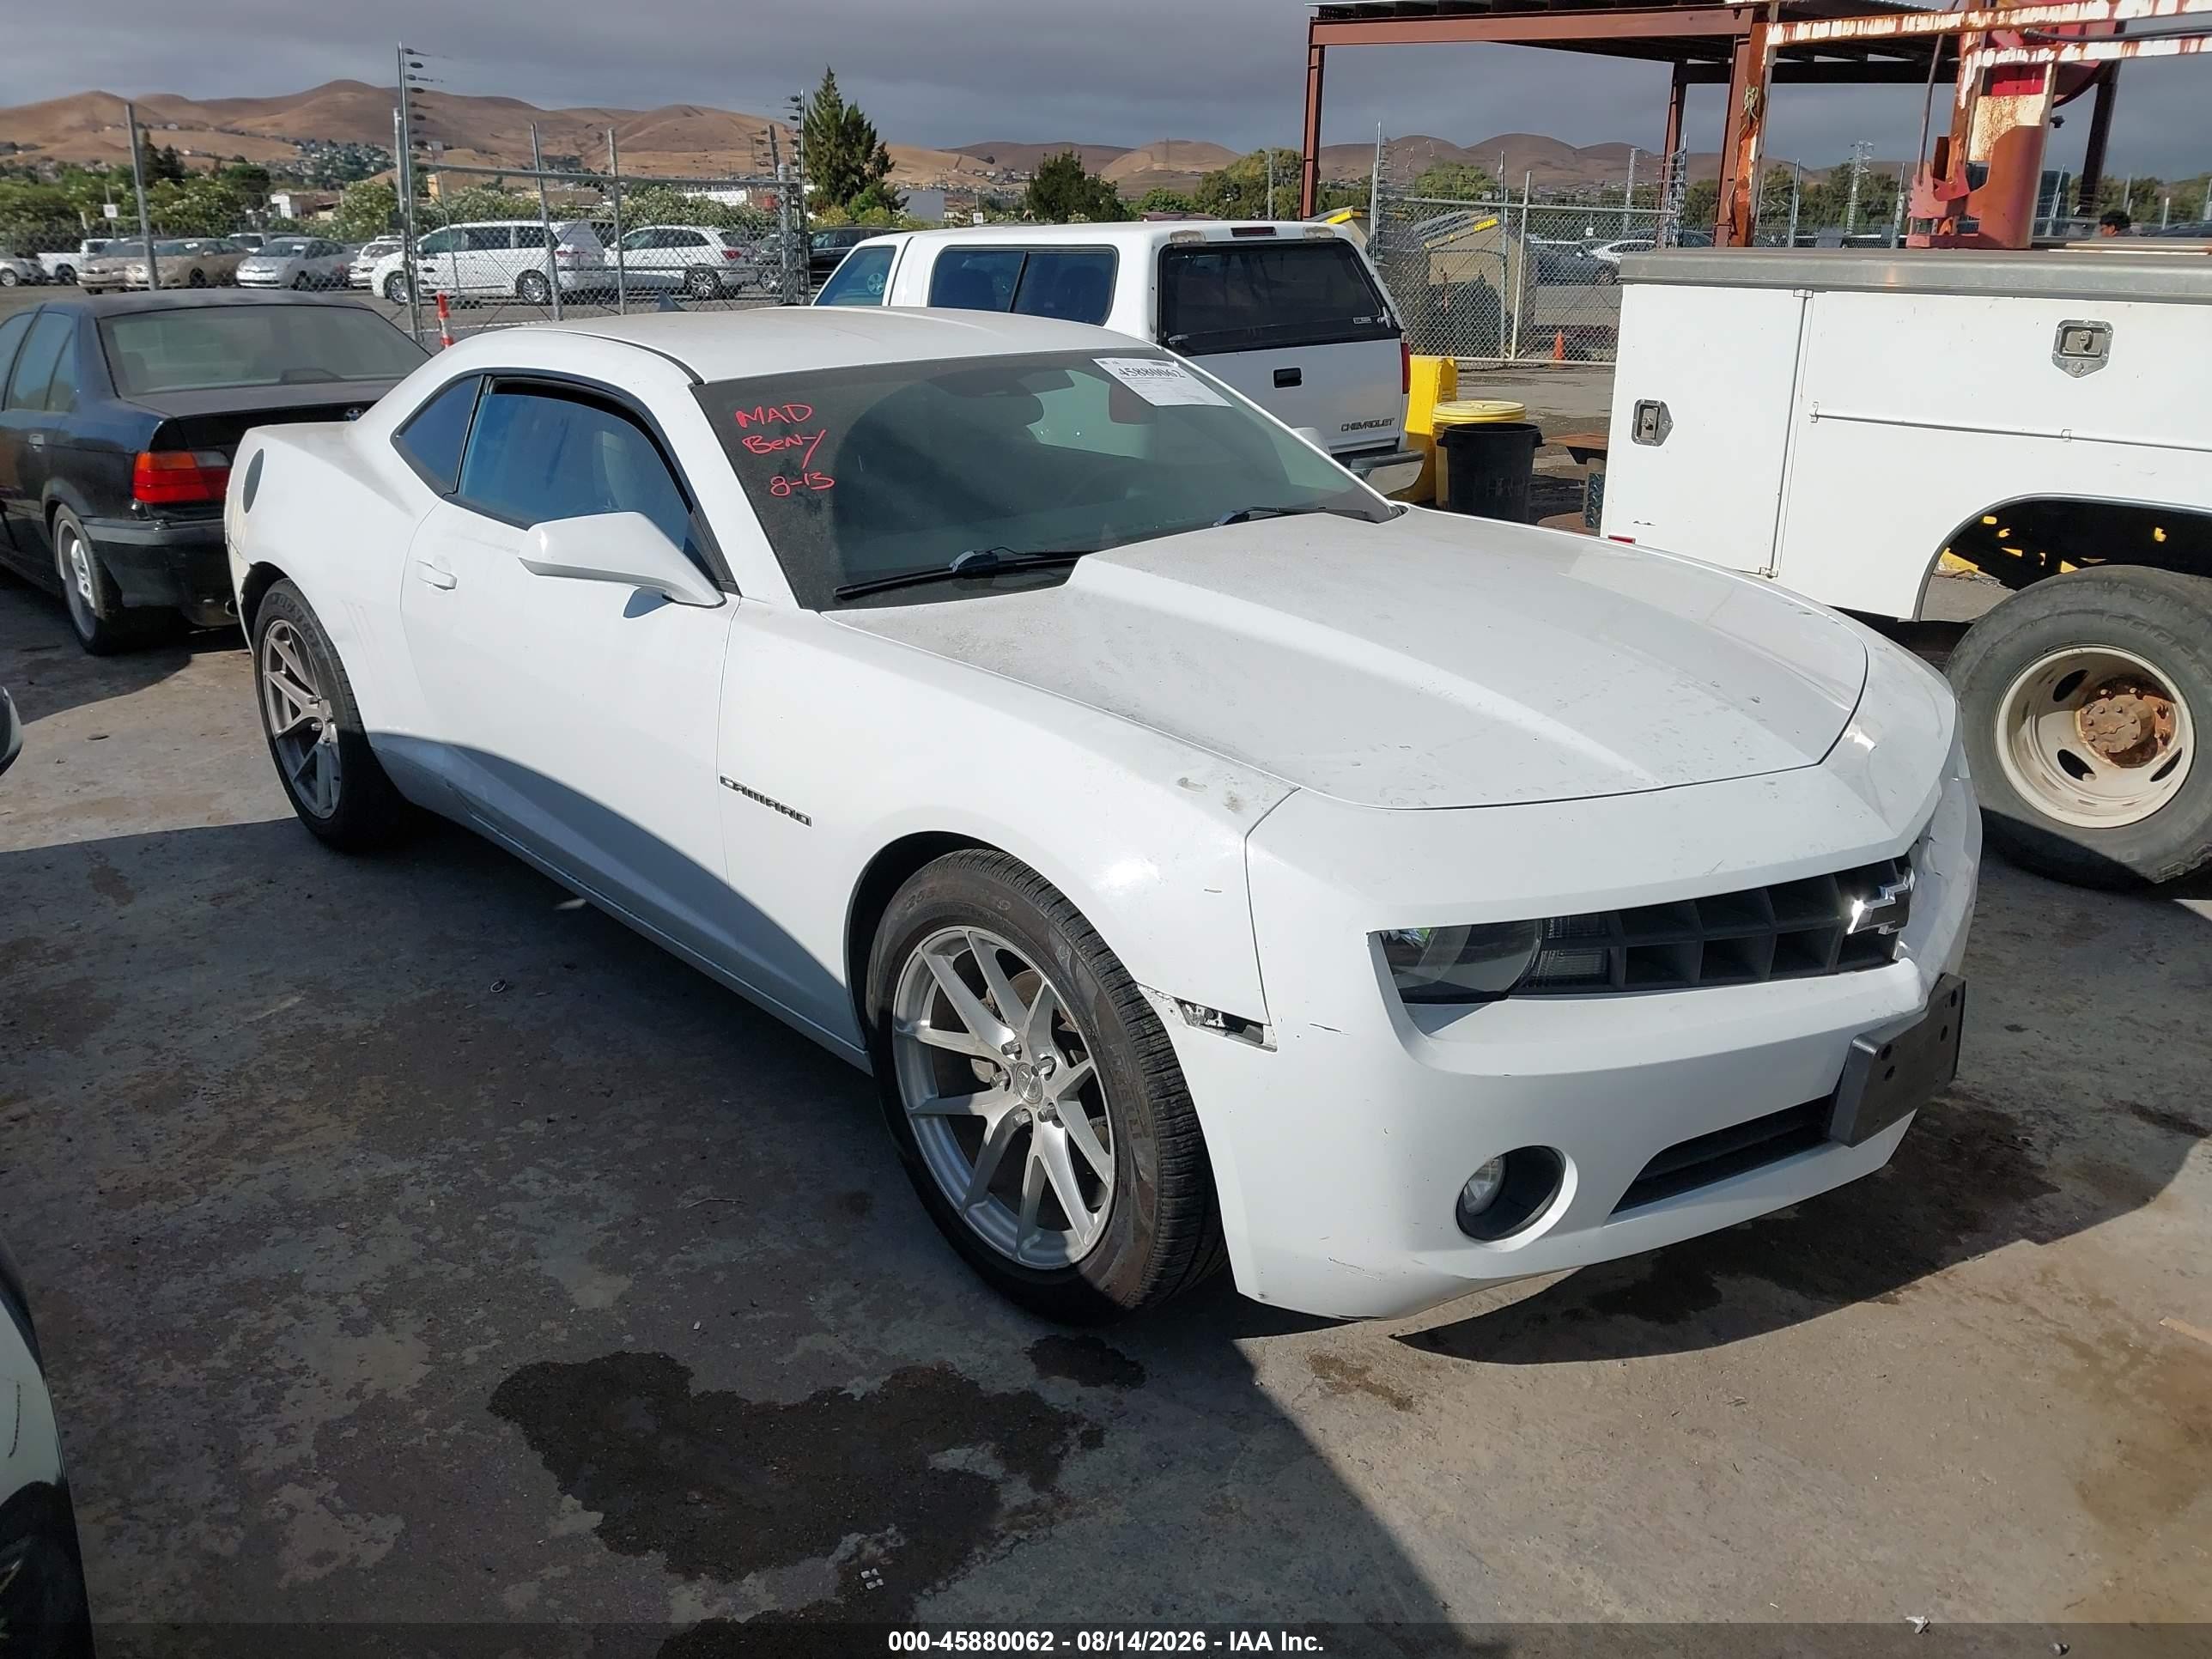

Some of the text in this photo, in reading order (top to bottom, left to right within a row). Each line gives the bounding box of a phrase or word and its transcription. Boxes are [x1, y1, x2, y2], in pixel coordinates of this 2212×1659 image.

[1118, 368, 1187, 379] 45880062
[735, 403, 813, 428] MAD
[1340, 417, 1395, 432] CHEVROLET
[720, 775, 812, 827] CAMARO
